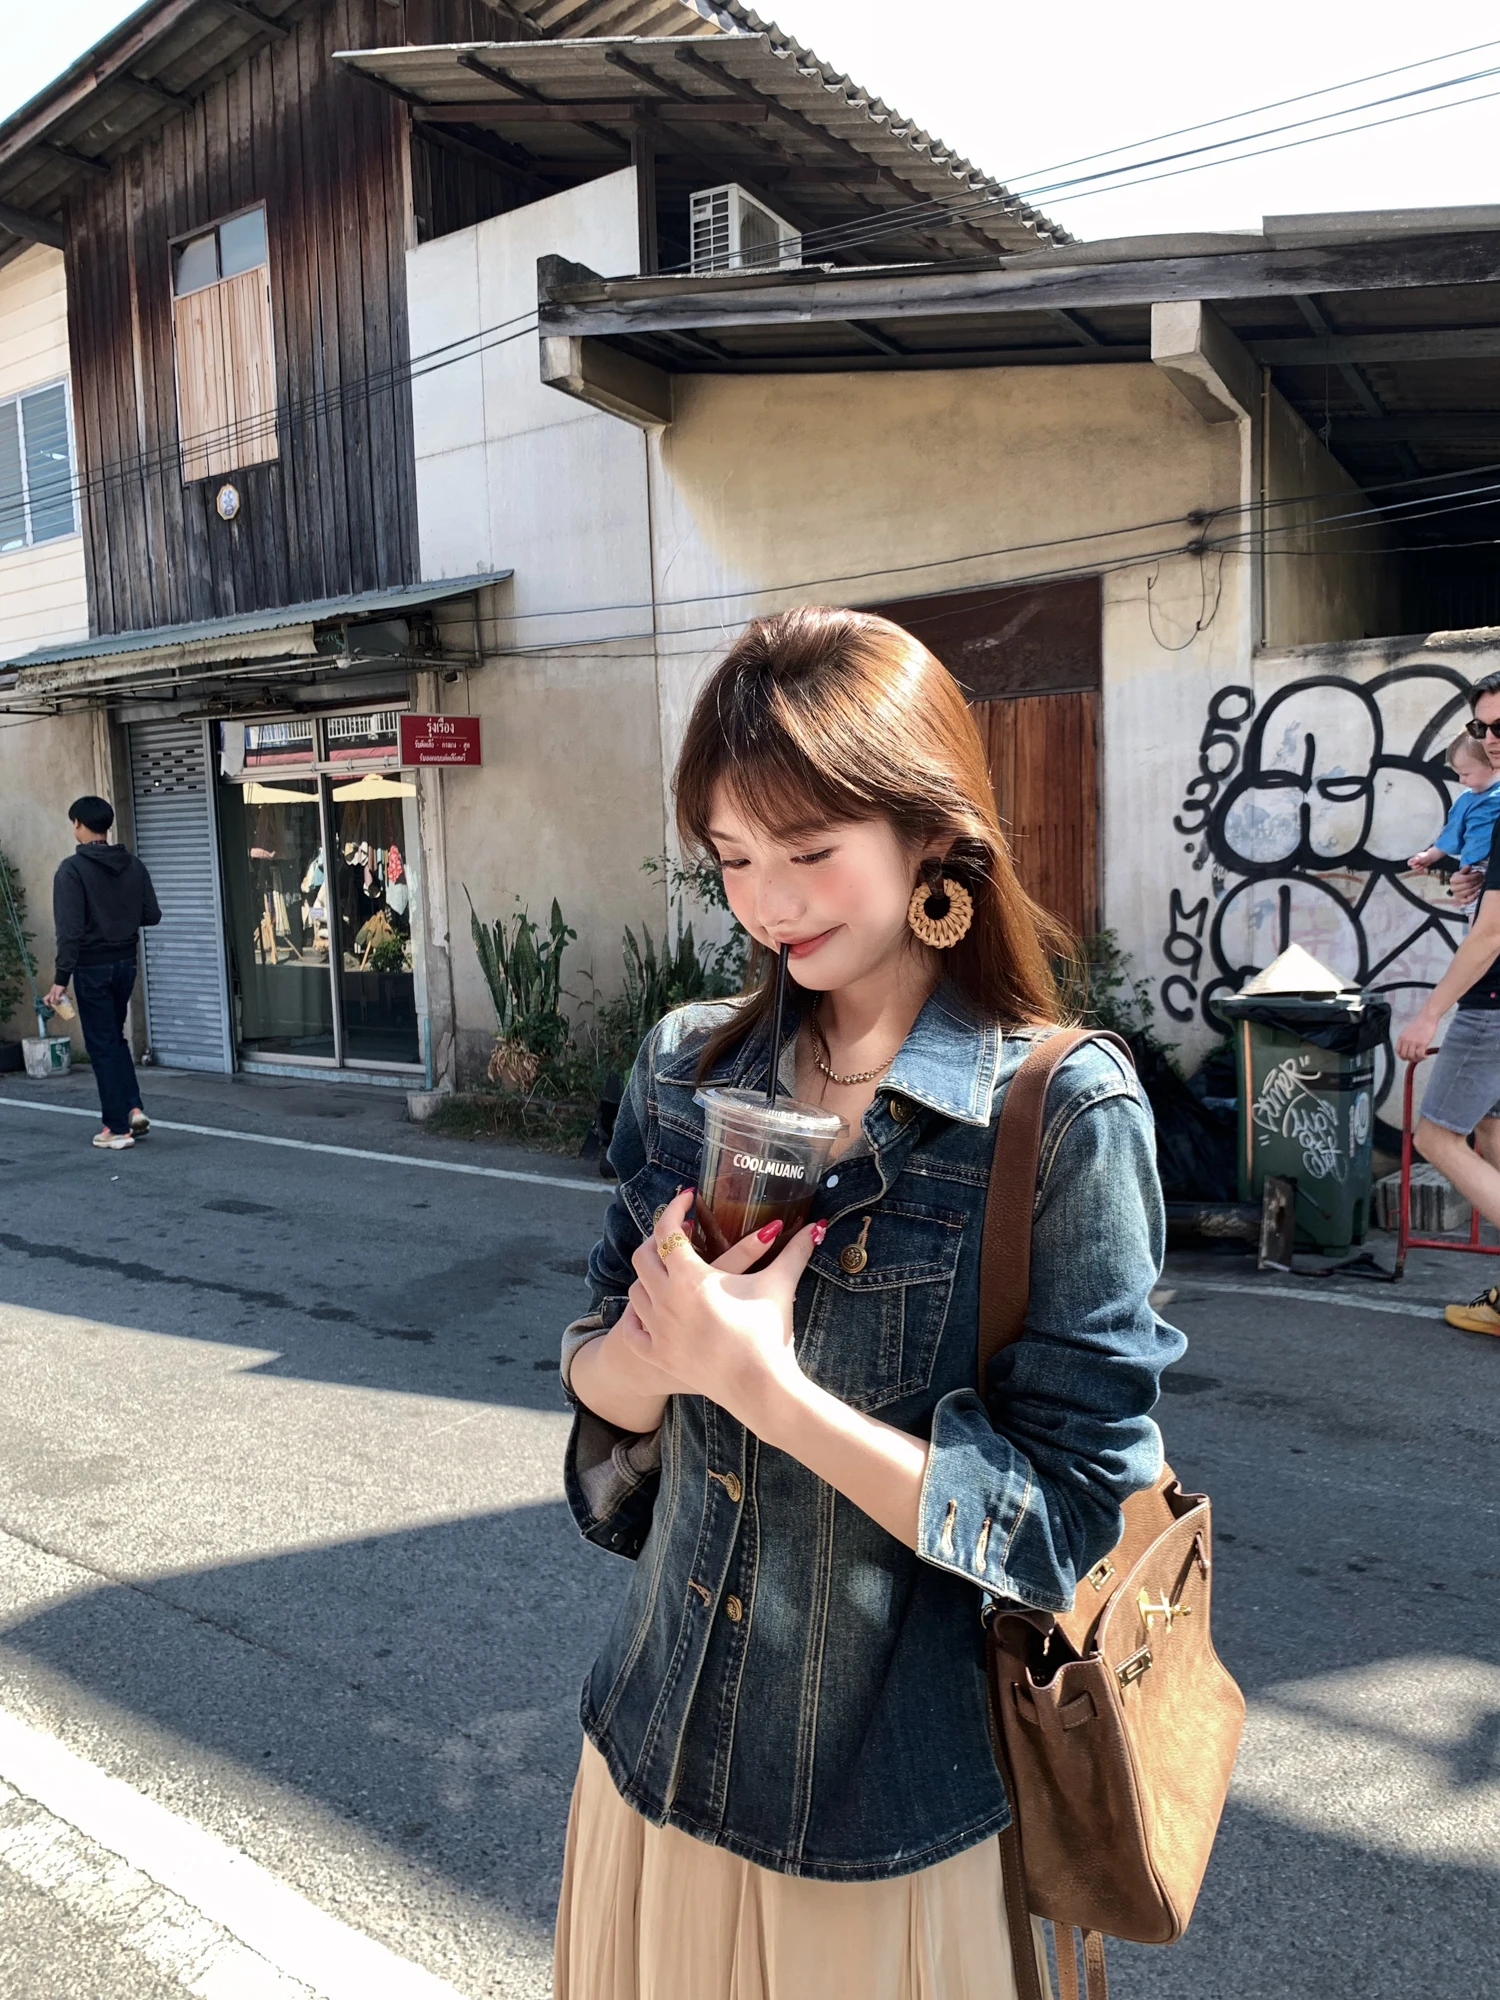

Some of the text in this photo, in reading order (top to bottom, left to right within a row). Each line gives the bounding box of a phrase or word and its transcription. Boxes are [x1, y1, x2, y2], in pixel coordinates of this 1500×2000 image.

[426, 717, 455, 738] รุ่งเรือง
[732, 1153, 805, 1180] COOLMUANG
